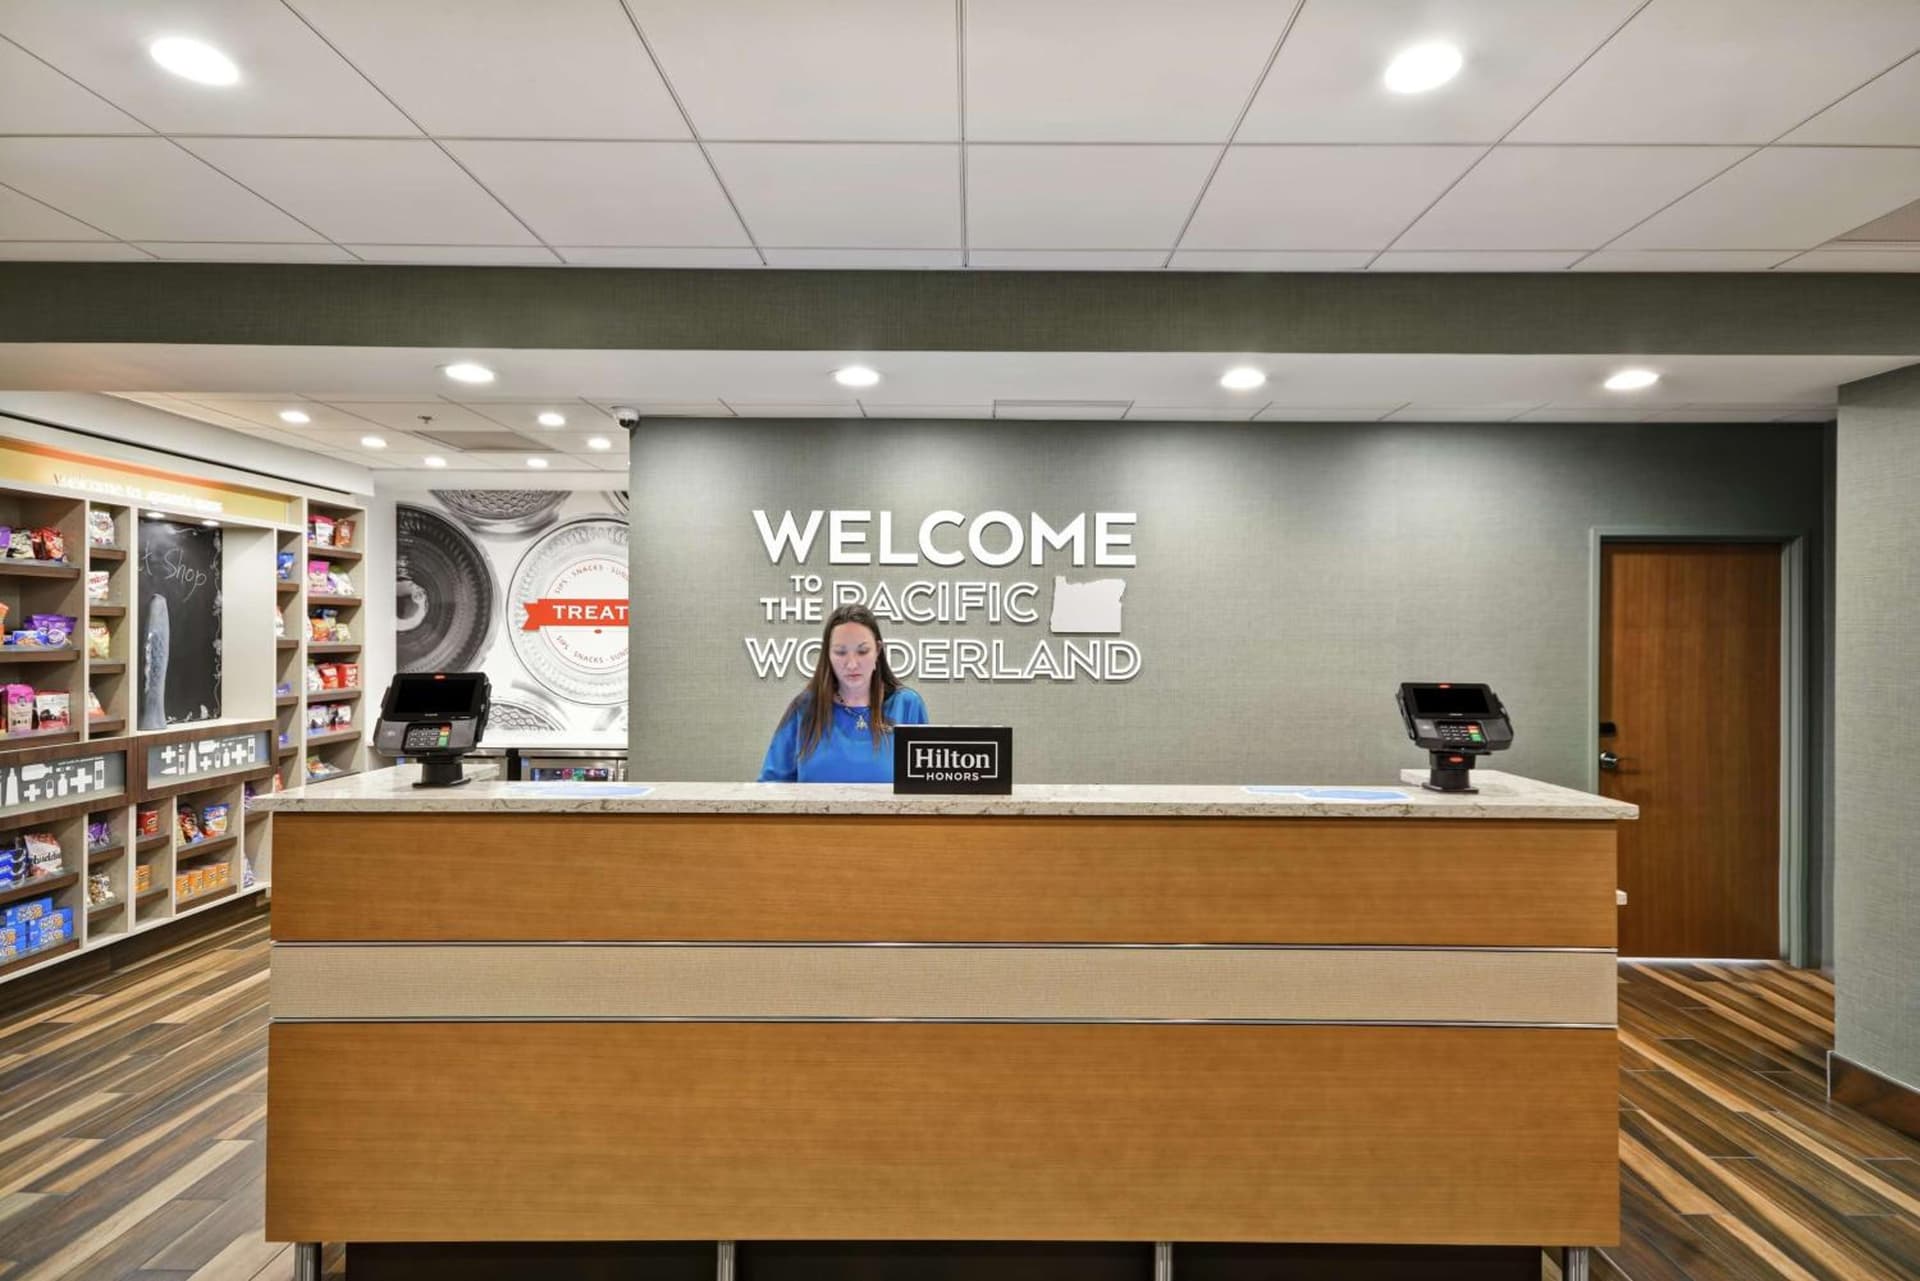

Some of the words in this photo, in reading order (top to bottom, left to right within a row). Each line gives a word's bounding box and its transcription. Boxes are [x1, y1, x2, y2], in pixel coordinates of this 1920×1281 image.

[752, 510, 1136, 565] WELCOME
[164, 548, 207, 602] Shop
[790, 575, 822, 592] TO
[760, 597, 823, 621] THE
[833, 581, 1039, 622] PACIFIC
[552, 605, 628, 620] TREAT
[573, 650, 604, 664] SNACKS
[745, 638, 1142, 680] WODERLAND
[915, 748, 990, 769] Hilton
[926, 772, 980, 781] HONORS
